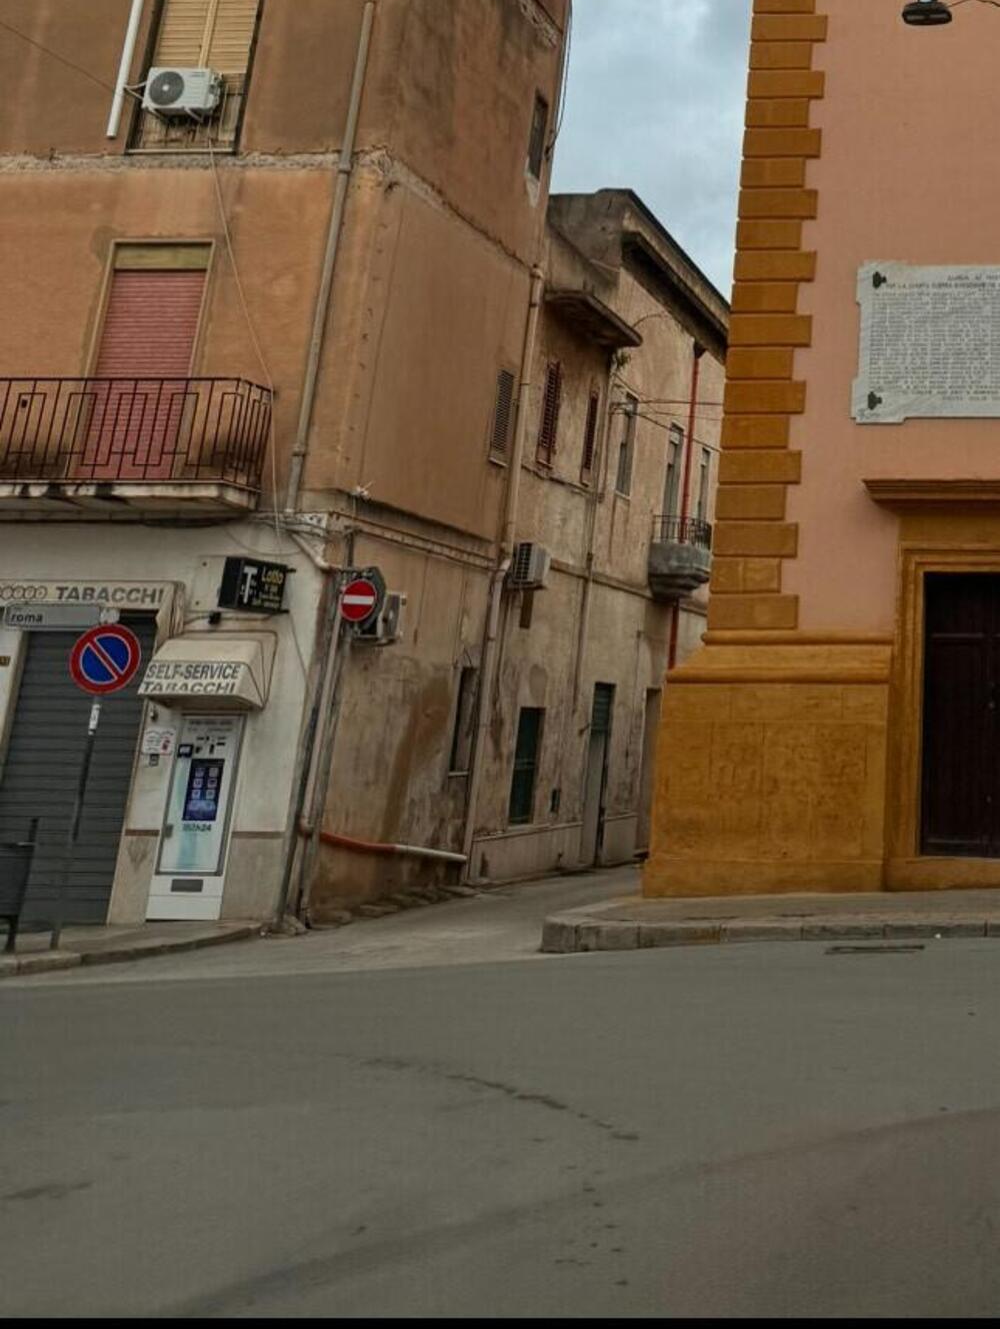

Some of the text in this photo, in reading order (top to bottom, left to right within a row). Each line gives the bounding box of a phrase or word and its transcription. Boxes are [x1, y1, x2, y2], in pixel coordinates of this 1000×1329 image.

[55, 586, 165, 604] TABACCHI
[11, 612, 43, 623] roma
[146, 663, 241, 680] SELF-SERVICE
